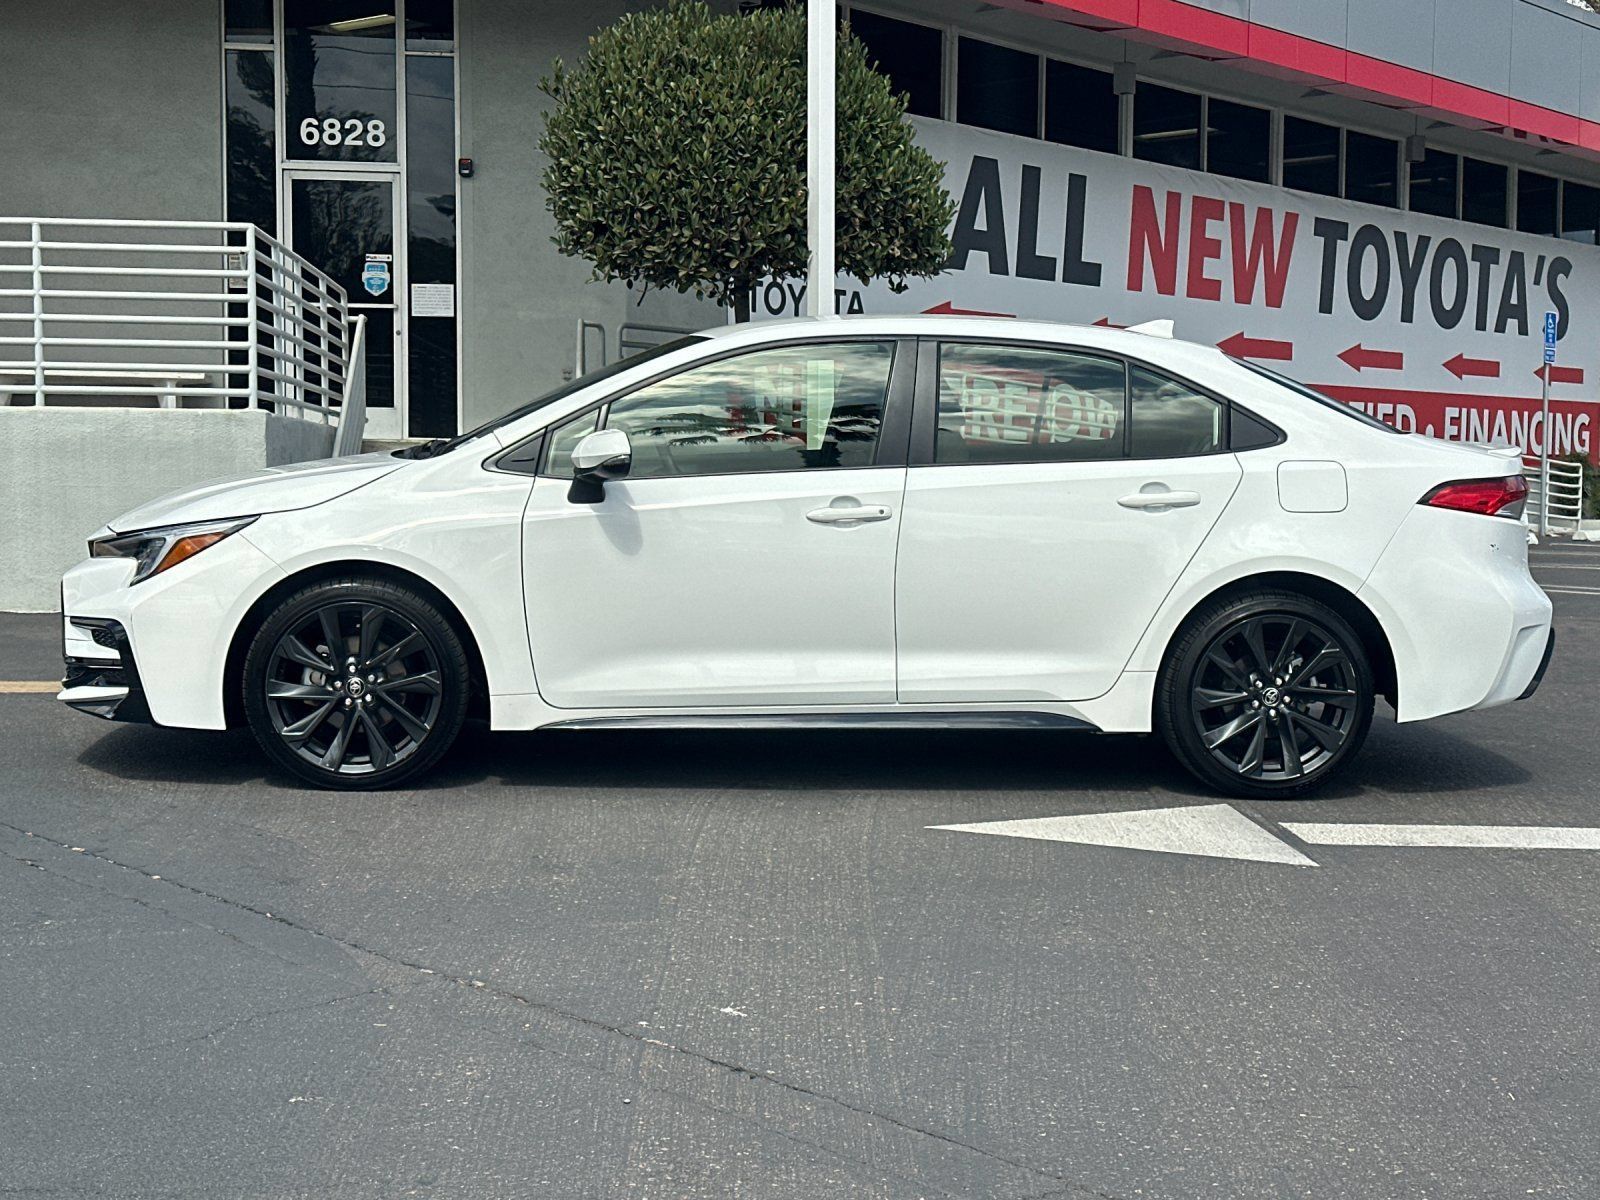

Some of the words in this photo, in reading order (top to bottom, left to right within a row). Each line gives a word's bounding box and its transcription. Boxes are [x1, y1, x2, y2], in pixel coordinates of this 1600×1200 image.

[300, 117, 386, 147] 6828
[943, 155, 1103, 287] ALL
[1126, 184, 1300, 308] NEW
[1313, 217, 1573, 341] TOYOTA'S
[749, 280, 865, 317] TOYTA
[1443, 406, 1591, 456] FINANCING
